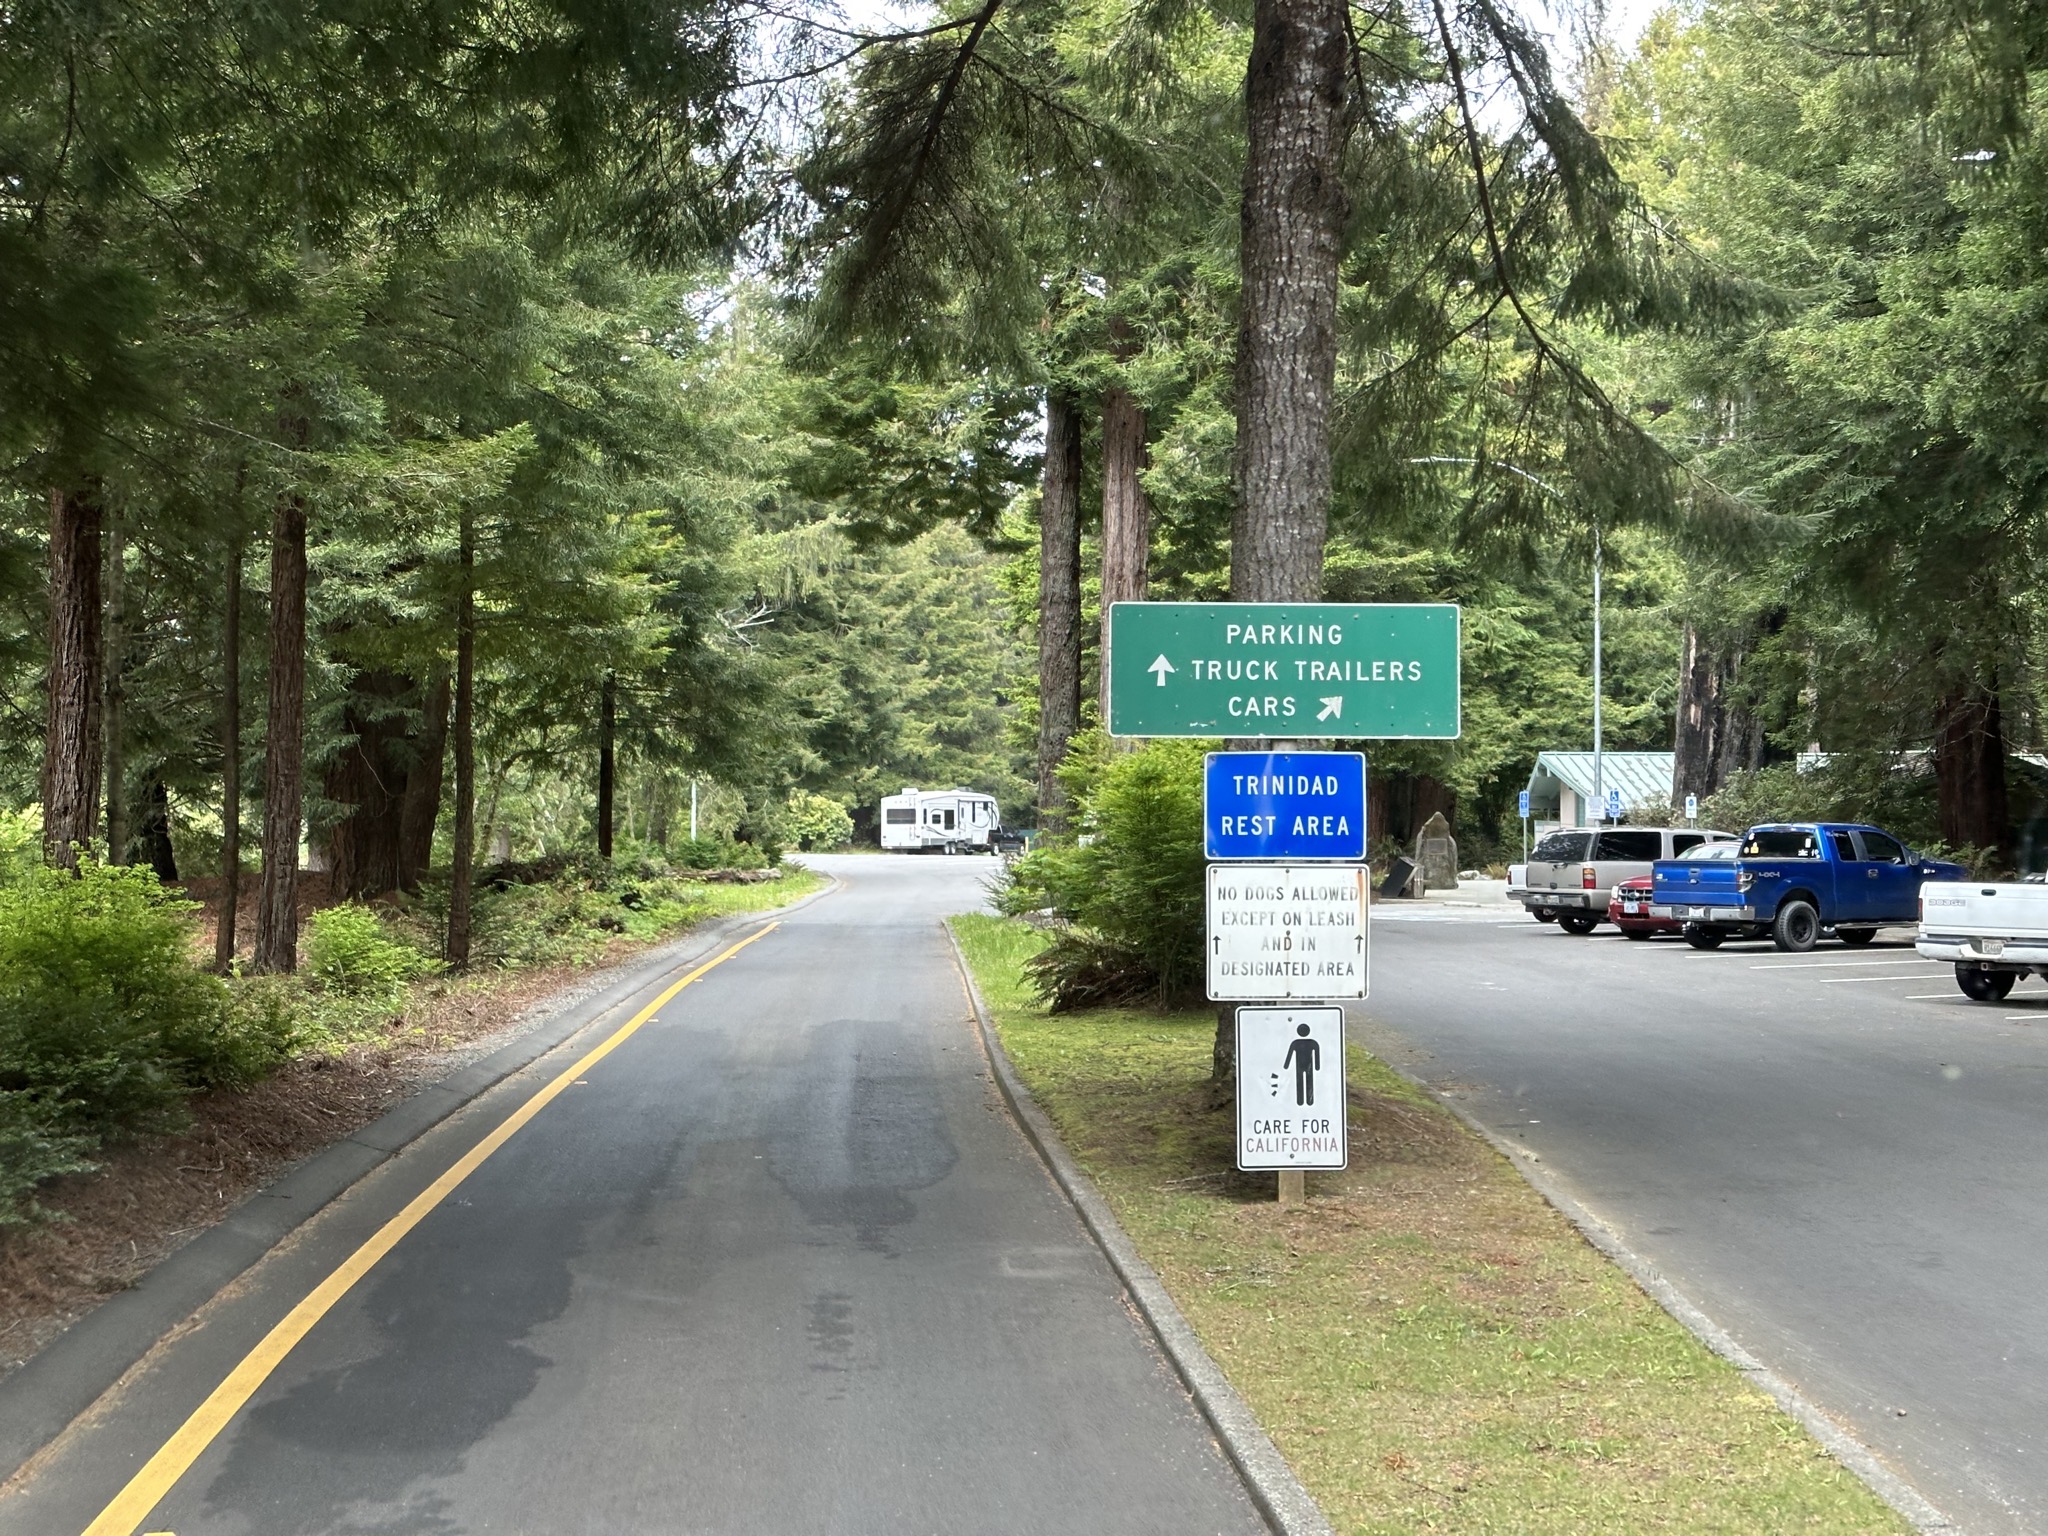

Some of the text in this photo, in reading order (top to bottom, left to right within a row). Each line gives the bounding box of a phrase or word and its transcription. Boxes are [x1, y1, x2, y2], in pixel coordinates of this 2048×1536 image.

[1226, 624, 1343, 645] PARKING
[1191, 660, 1422, 681] TRUCK TRAILERS
[1228, 696, 1296, 717] CARS
[1233, 775, 1339, 796] TRINIDAD
[1221, 815, 1350, 836] REST AREA
[1217, 886, 1359, 901] NO DOGS ALLOWED
[1221, 911, 1355, 926] EXCEPT ON LEASH
[1261, 936, 1316, 951] AND IN
[1221, 962, 1354, 976] DESIGNATED AREA
[1253, 1119, 1330, 1134] CARE FOR
[1246, 1137, 1338, 1153] CALIFORNIA
